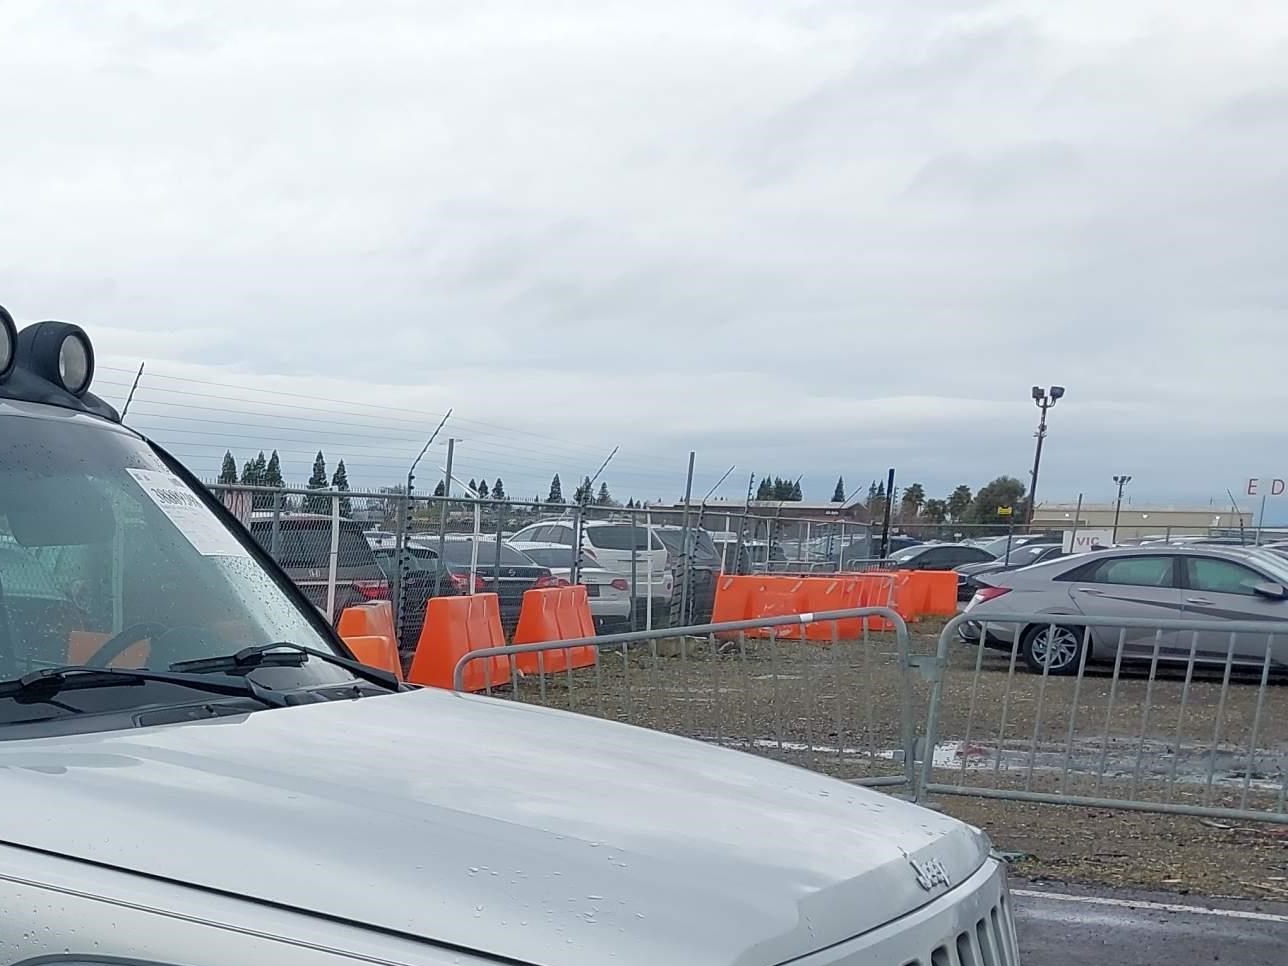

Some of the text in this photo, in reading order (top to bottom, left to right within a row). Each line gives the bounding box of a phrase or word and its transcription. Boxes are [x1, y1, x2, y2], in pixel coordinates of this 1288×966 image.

[1247, 478, 1285, 496] E D
[908, 858, 951, 892] Jeep
